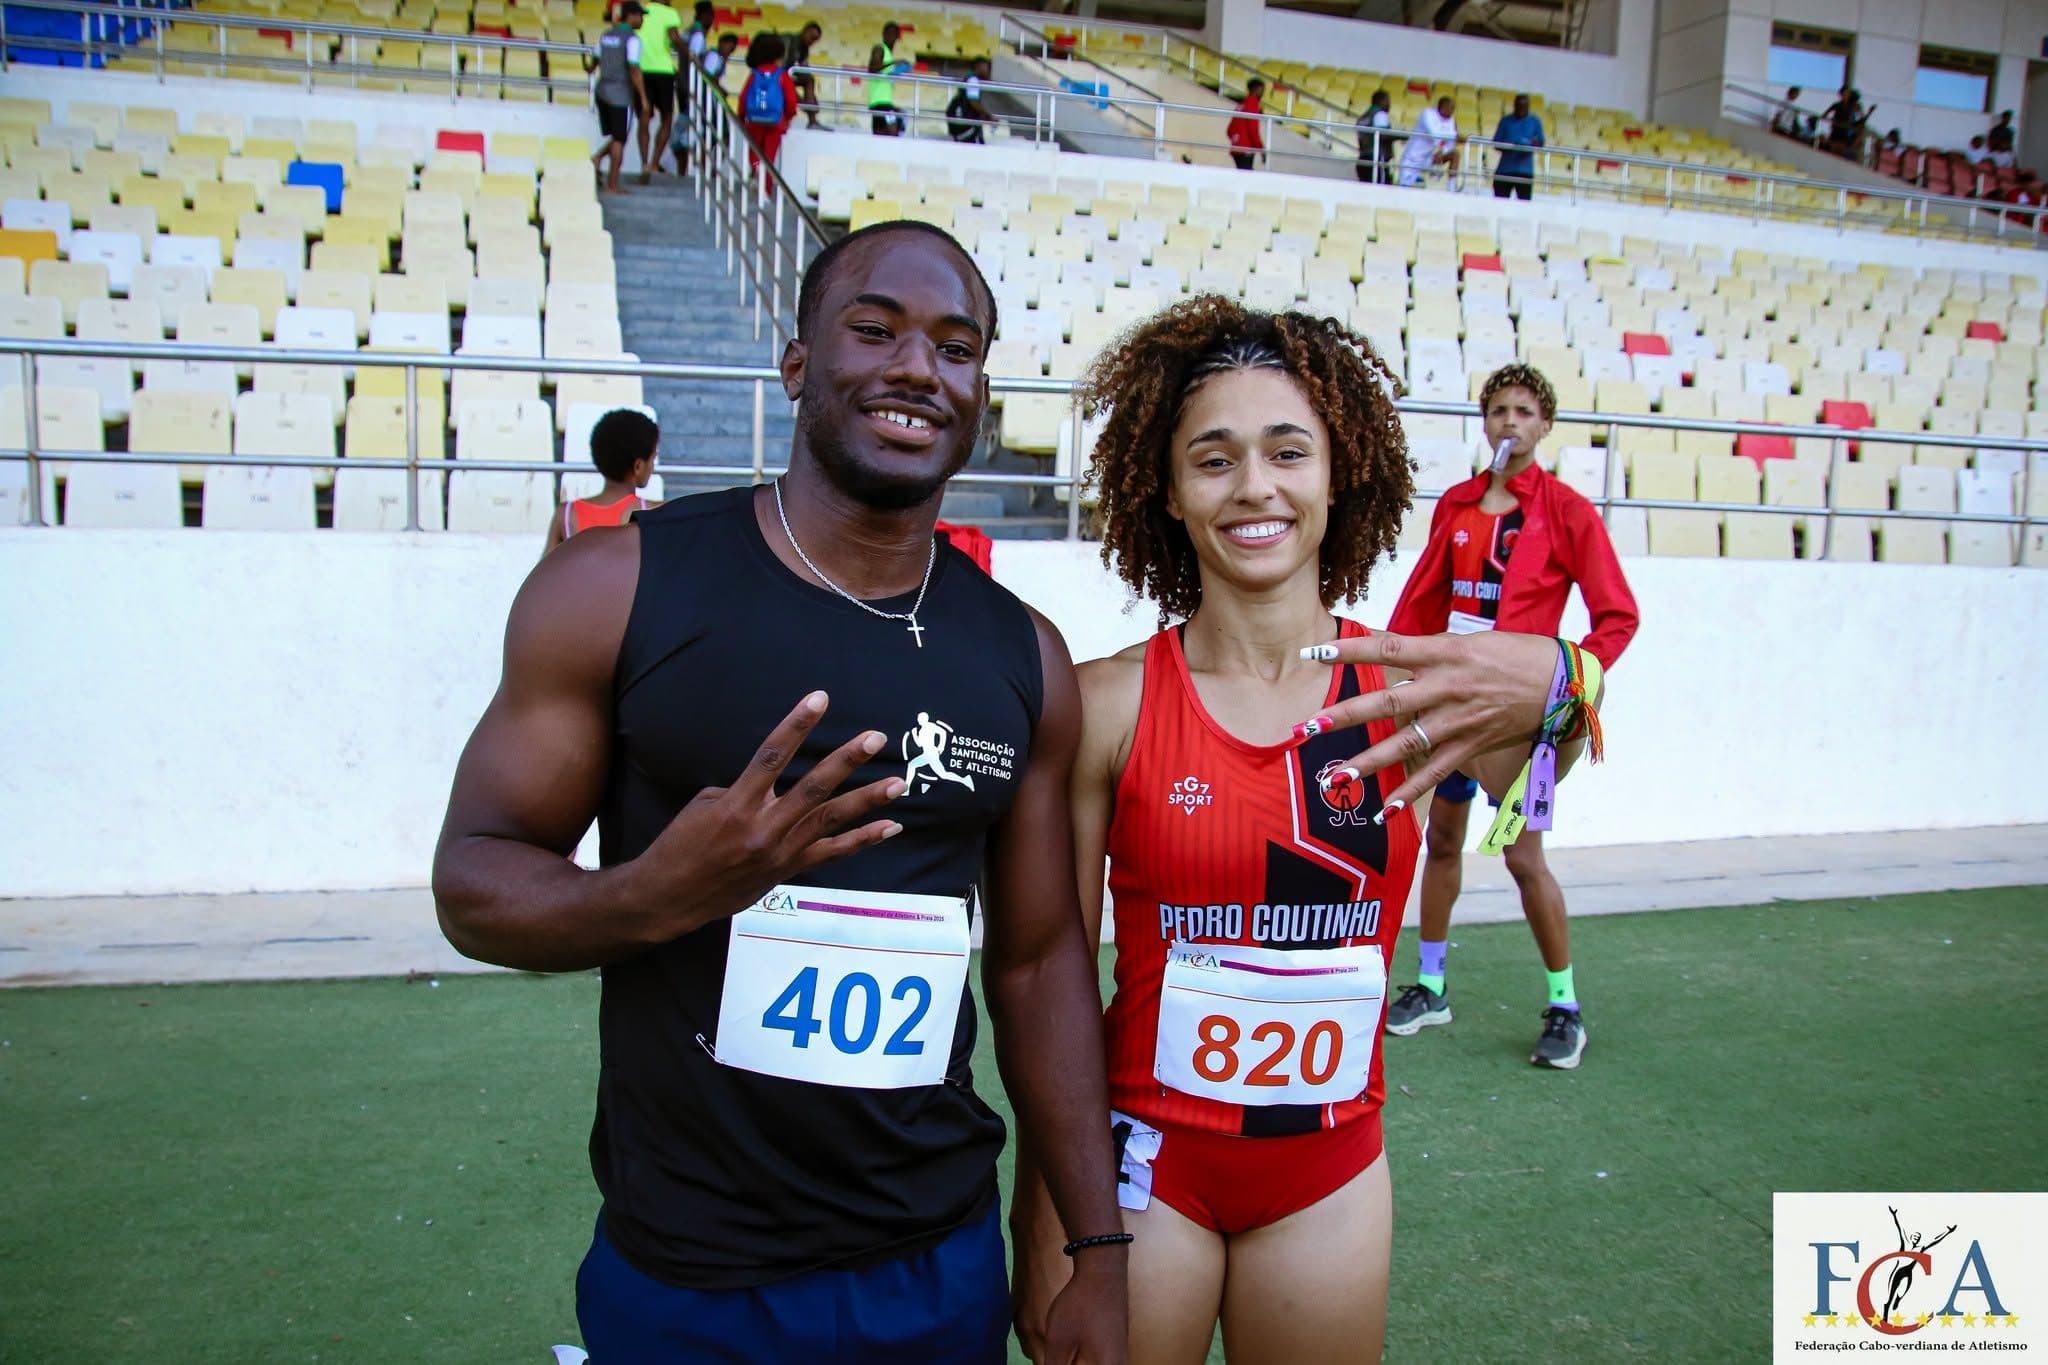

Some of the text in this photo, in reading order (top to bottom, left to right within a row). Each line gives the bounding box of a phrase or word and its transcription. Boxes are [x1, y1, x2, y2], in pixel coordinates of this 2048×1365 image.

[951, 735, 1015, 757] ASSOCIAÇÃO
[951, 747, 1013, 769] SANTIAGO SUL
[949, 759, 1011, 780] DE ATLETISMO
[1168, 793, 1213, 806] SPORT
[1159, 900, 1382, 943] PEDRO COUTINHO
[1182, 952, 1218, 968] FCA
[761, 966, 932, 1056] 402
[1192, 1014, 1344, 1087] 820
